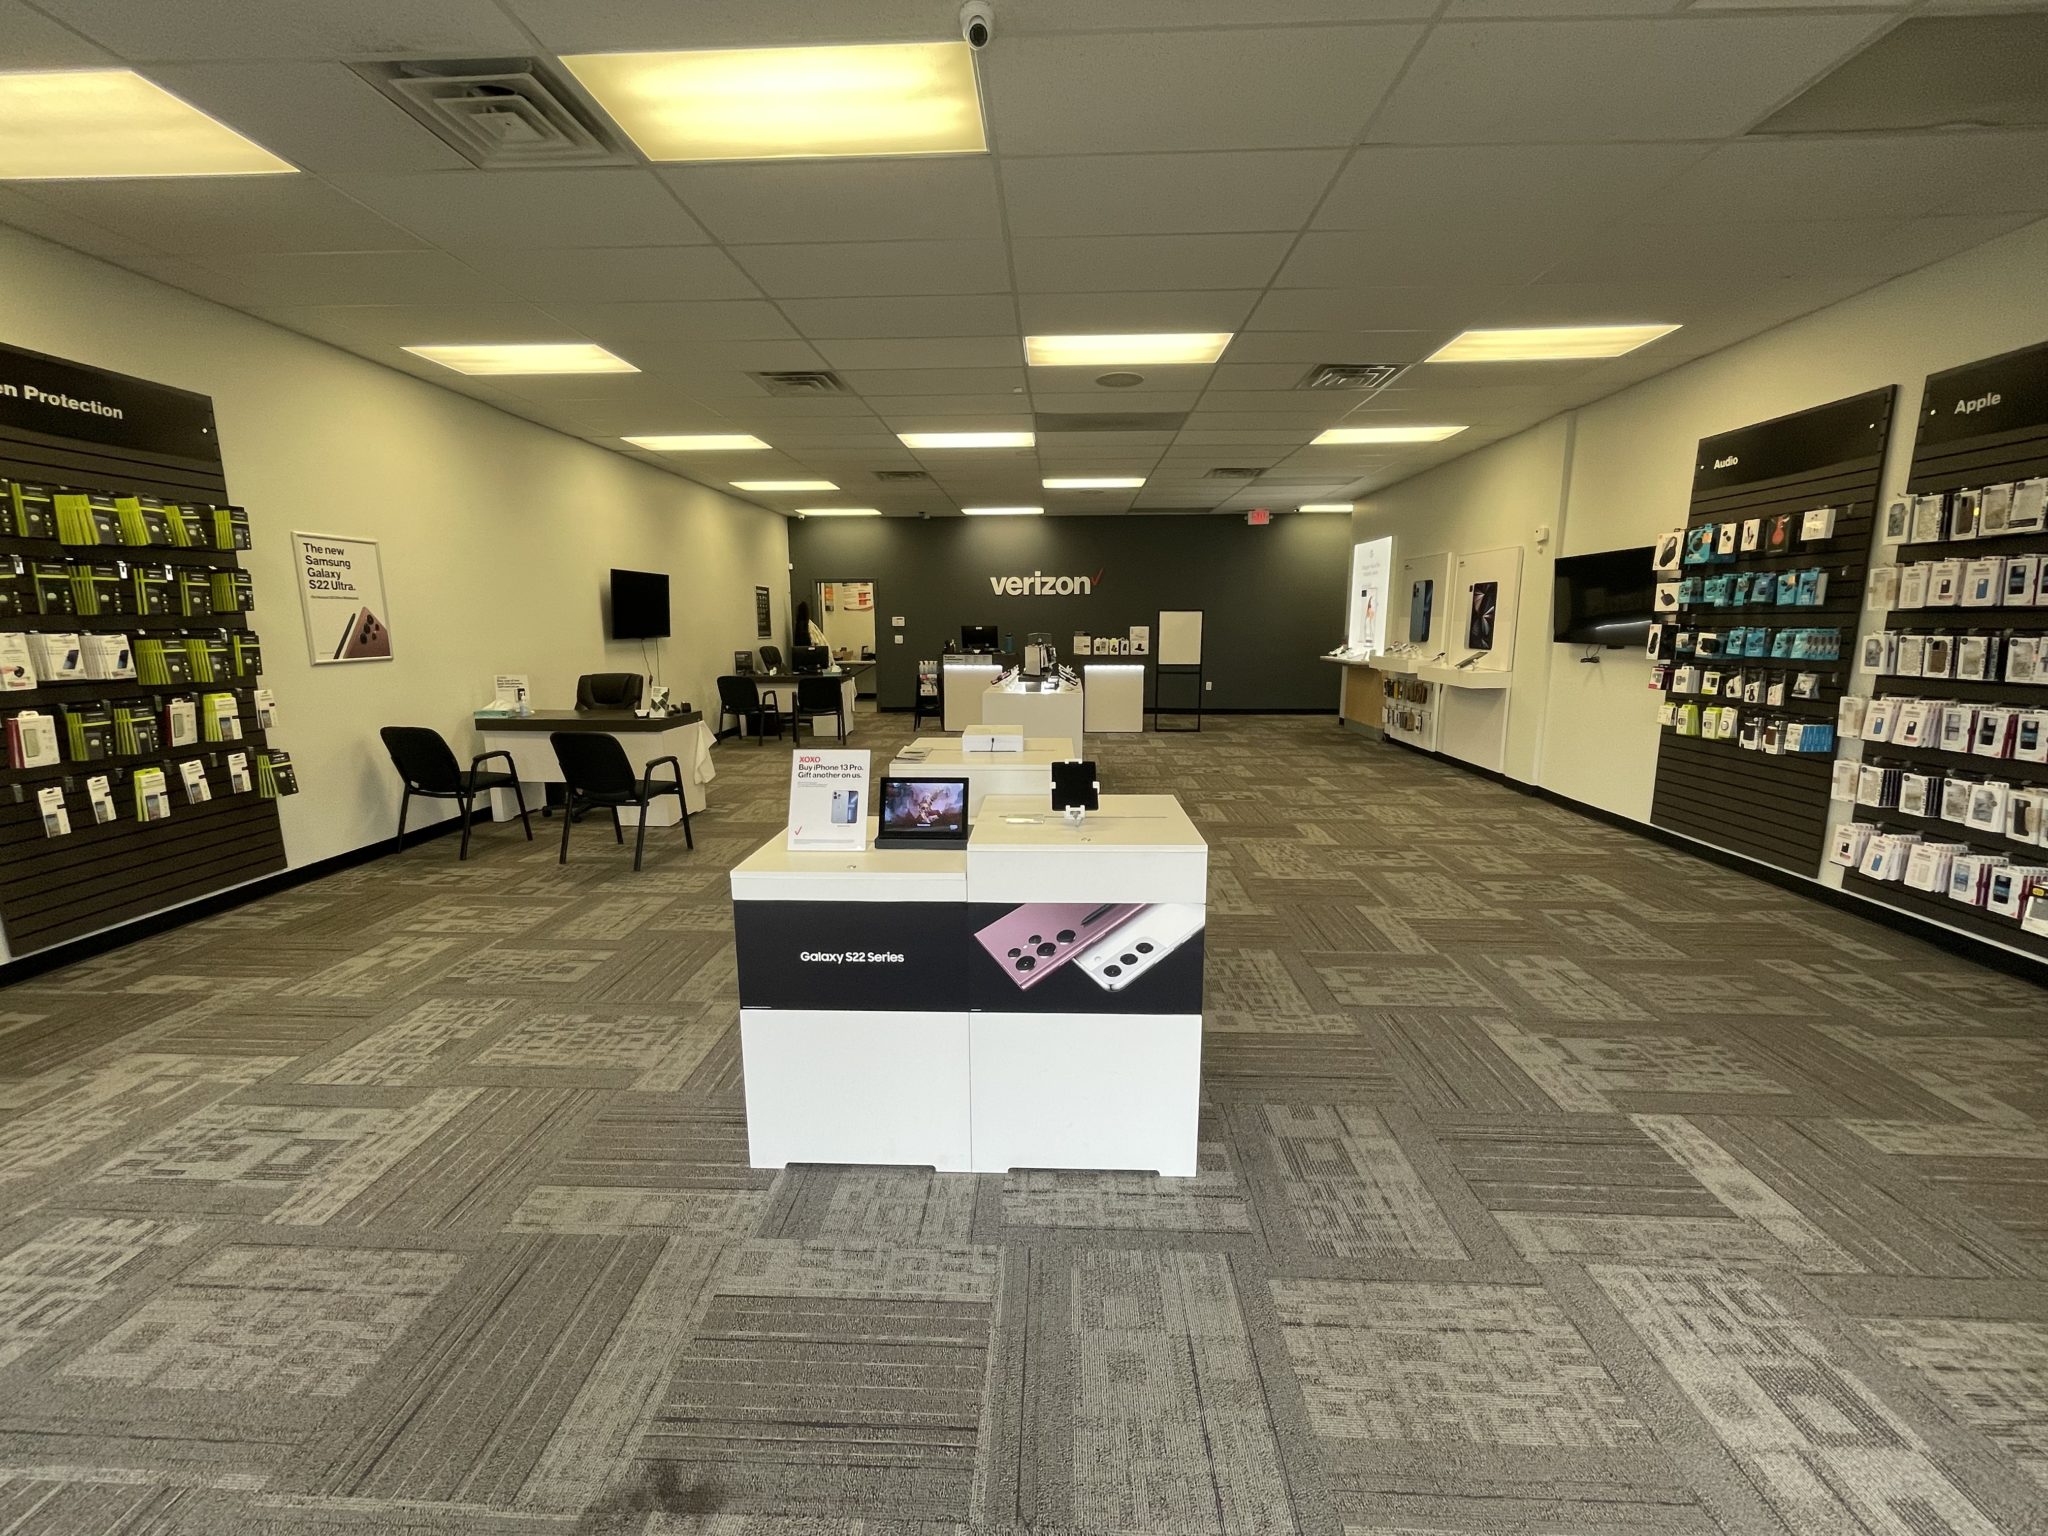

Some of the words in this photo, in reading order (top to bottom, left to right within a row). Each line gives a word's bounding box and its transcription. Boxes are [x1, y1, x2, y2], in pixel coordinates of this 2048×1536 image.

[23, 385, 123, 420] Protection
[1954, 392, 2001, 415] Apple
[1713, 455, 1739, 470] Audio
[303, 542, 323, 554] The
[325, 546, 344, 555] new
[305, 555, 351, 570] Samsung
[307, 567, 341, 581] Galaxy
[309, 580, 329, 589] S22
[331, 580, 356, 591] Ultra.
[989, 570, 1091, 596] verizon
[798, 763, 813, 771] Buy
[800, 951, 844, 965] Galaxy
[845, 951, 866, 963] S22
[867, 951, 905, 963] Series
